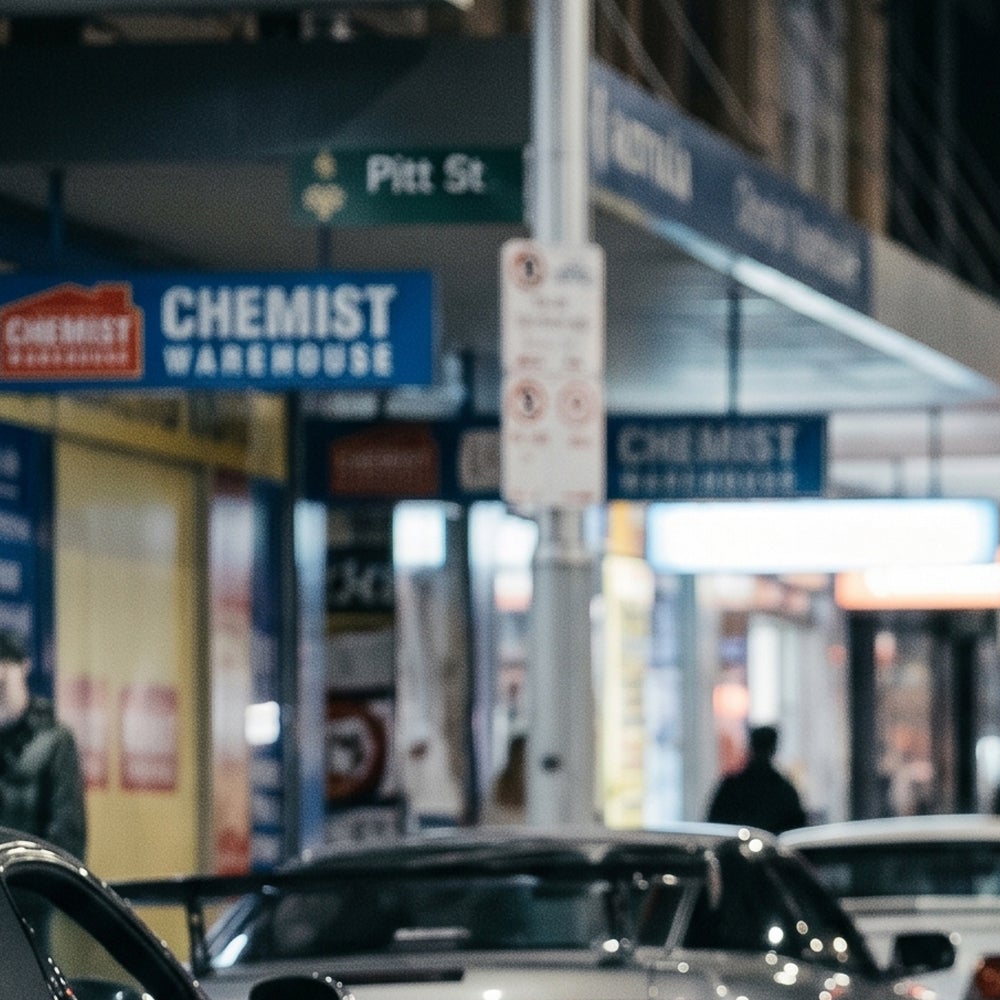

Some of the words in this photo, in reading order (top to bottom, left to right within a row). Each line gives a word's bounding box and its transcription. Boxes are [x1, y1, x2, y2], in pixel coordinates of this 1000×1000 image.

[366, 153, 433, 194] Pitt
[443, 152, 485, 194] St
[161, 284, 398, 341] CHEMIST
[162, 342, 394, 379] WAREHOUSE
